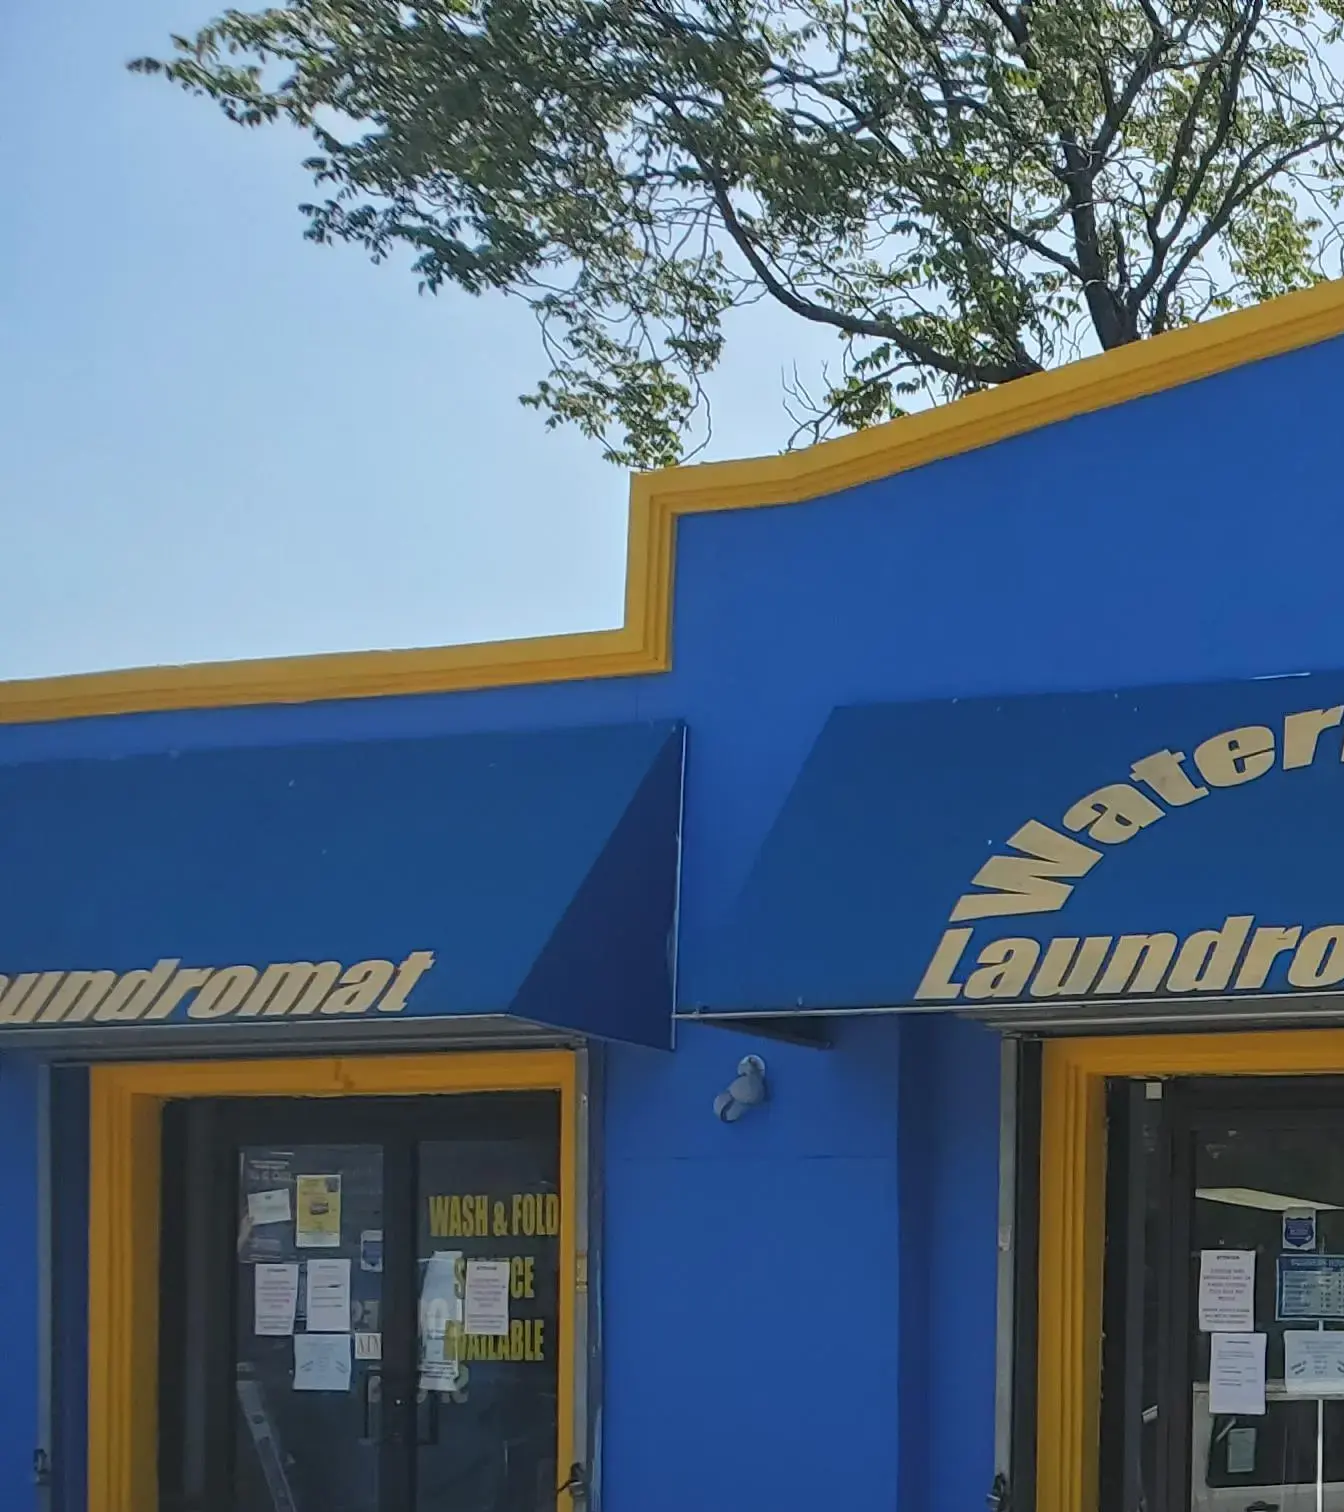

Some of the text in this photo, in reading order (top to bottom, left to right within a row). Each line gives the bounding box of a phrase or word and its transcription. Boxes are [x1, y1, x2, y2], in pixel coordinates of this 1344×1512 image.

[0, 951, 434, 1024] undromat
[429, 1193, 559, 1237] WASH & FOLD
